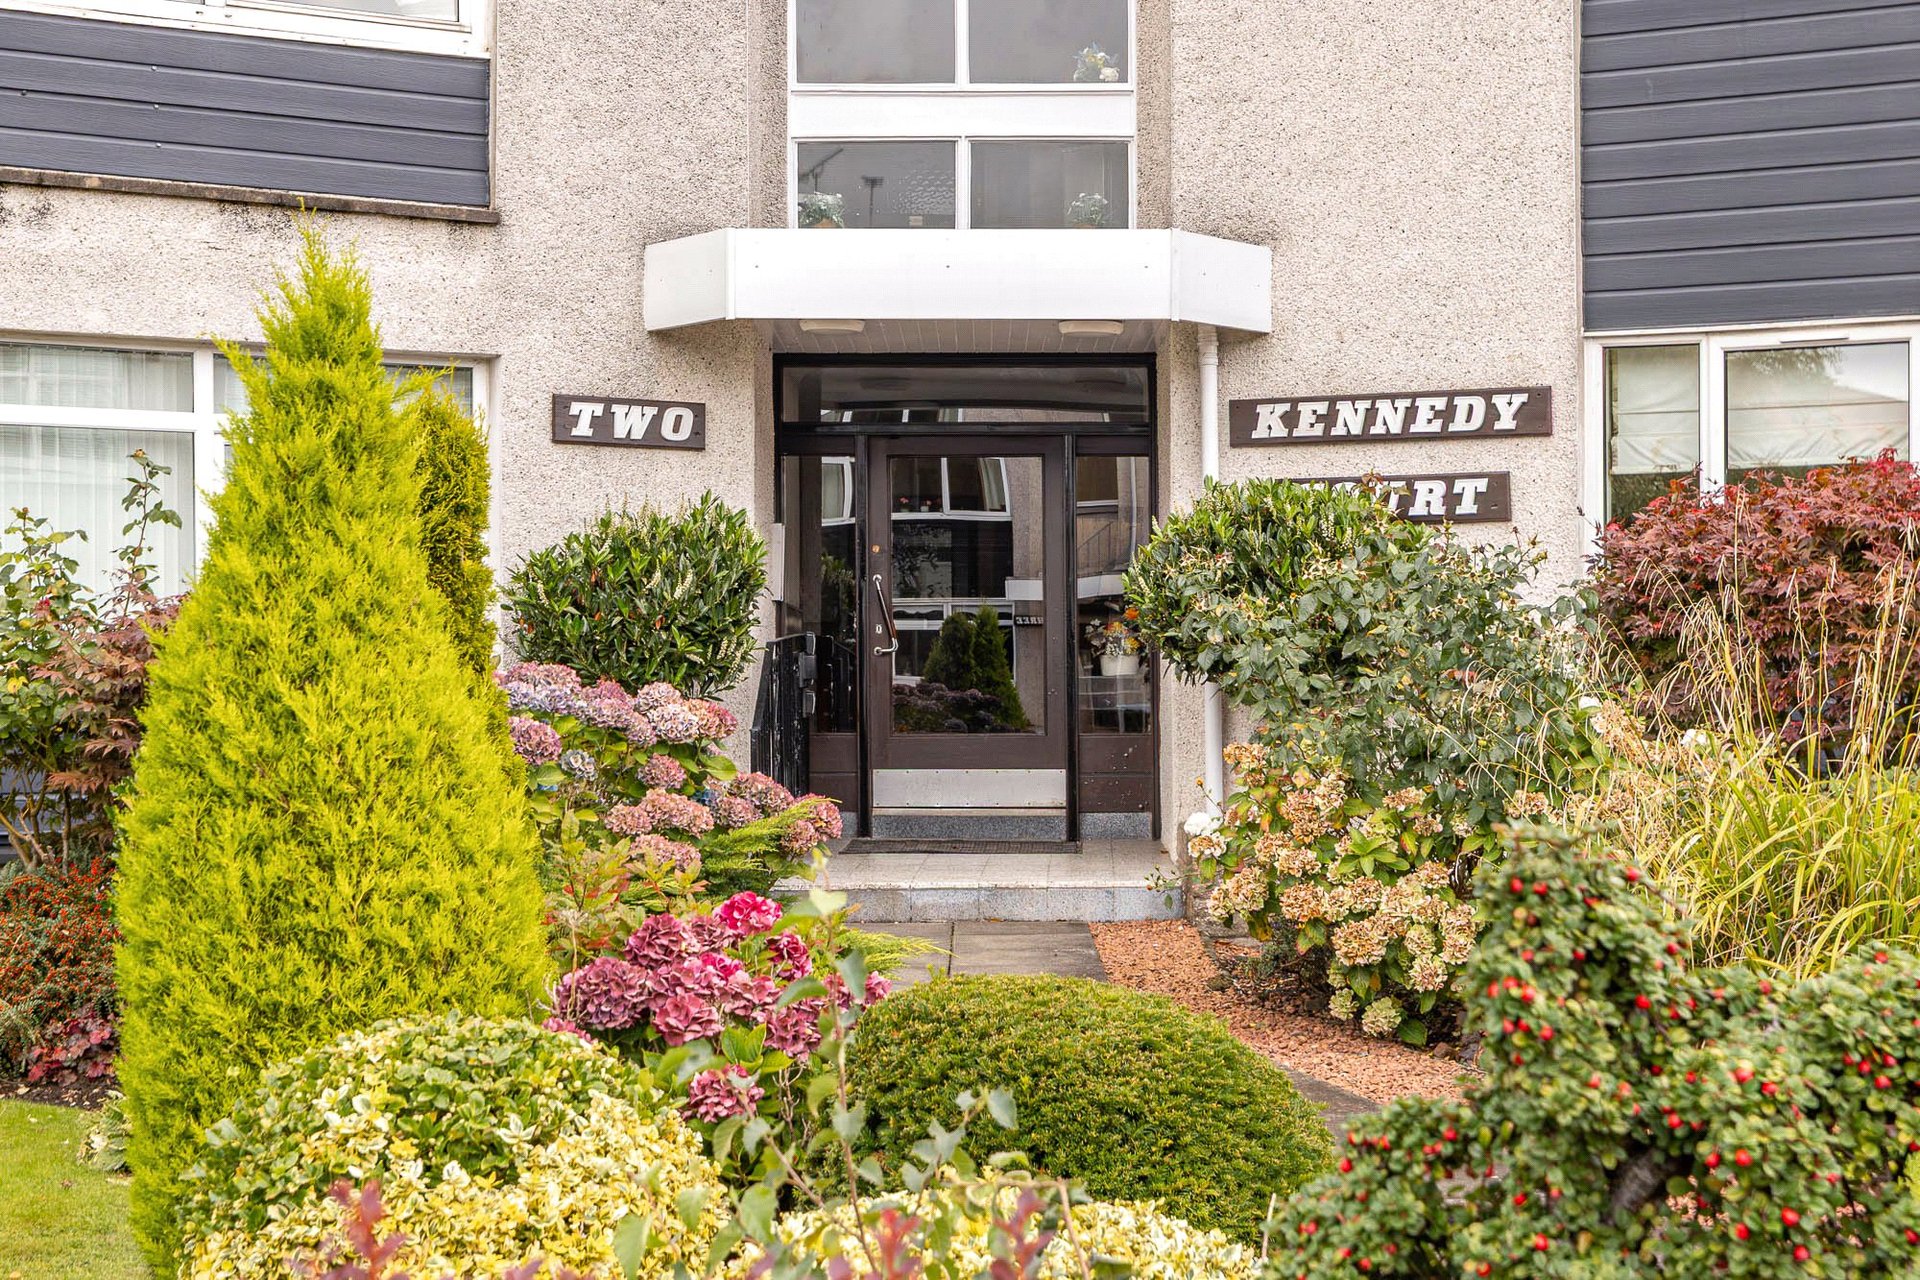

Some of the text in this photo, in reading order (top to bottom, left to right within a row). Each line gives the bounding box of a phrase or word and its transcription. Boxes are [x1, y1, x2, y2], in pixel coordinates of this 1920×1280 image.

[569, 401, 694, 441] TWO
[1251, 393, 1529, 439] KENNEDY
[1299, 478, 1489, 516] URT
